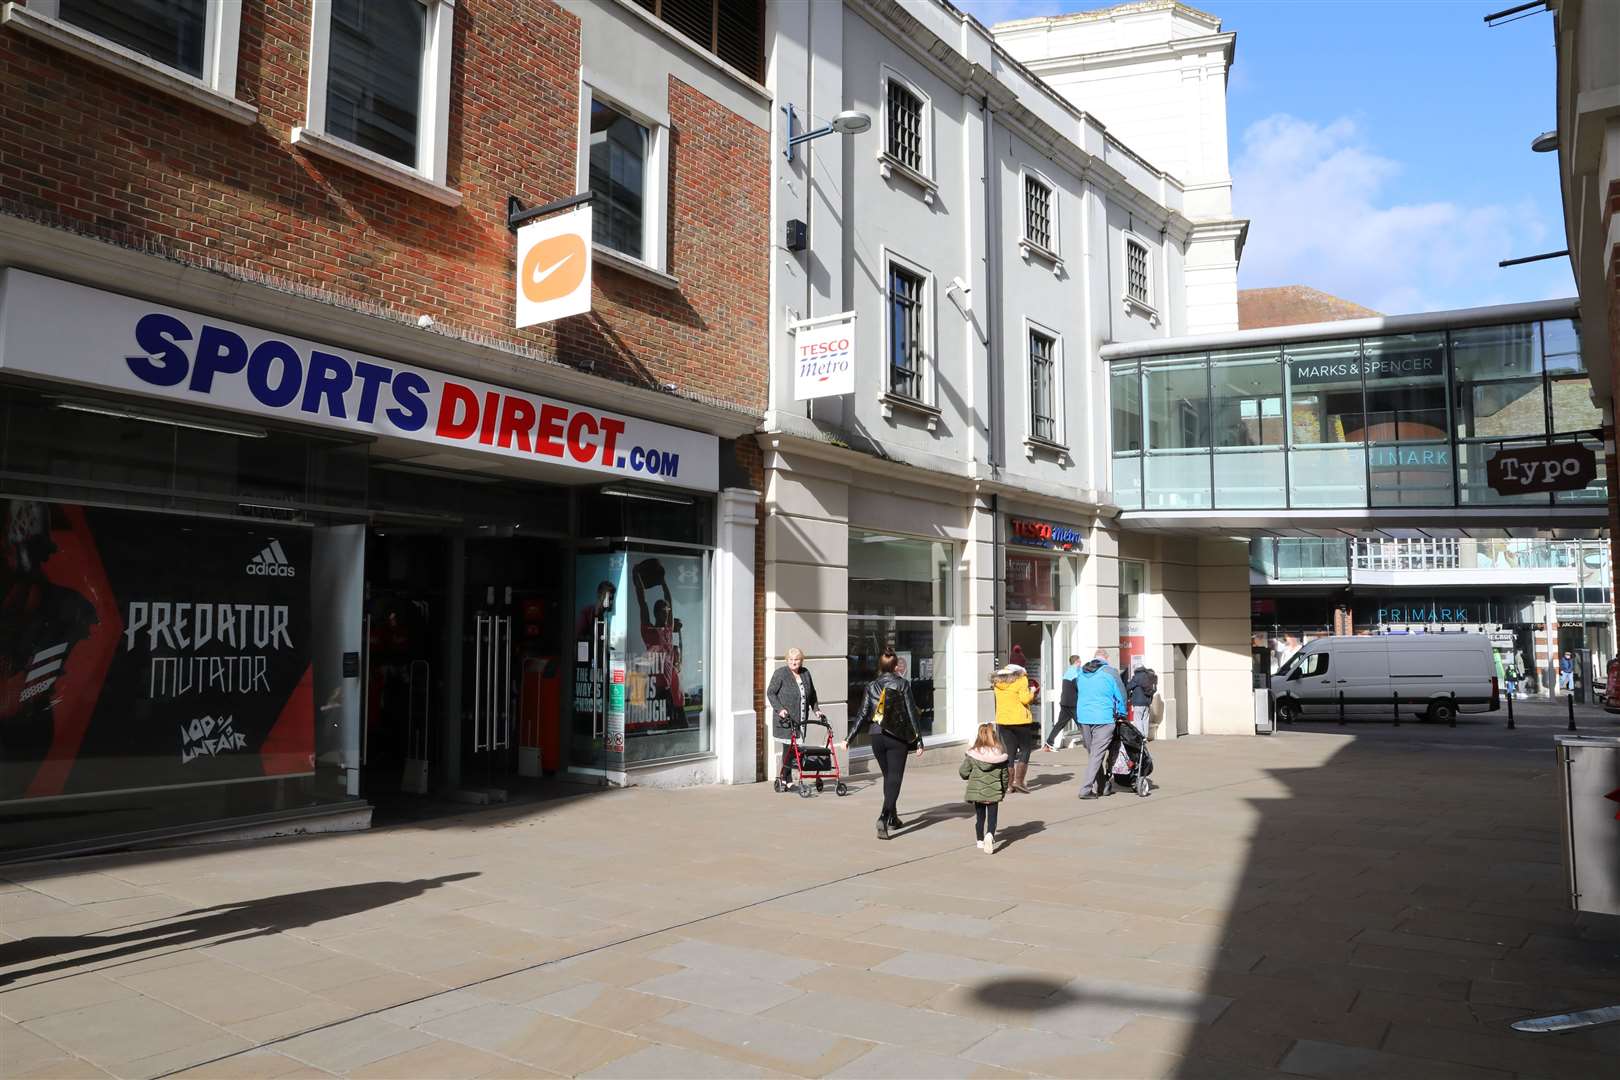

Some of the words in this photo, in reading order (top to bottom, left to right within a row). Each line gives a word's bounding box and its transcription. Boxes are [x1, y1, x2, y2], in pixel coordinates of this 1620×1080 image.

[800, 338, 849, 357] TESCO
[1298, 364, 1347, 379] MARKS
[1349, 363, 1360, 375] &
[1363, 358, 1433, 375] SPENCER
[1500, 458, 1580, 485] Typo
[1012, 519, 1052, 539] TESCO
[246, 561, 296, 577] adidas
[1377, 608, 1467, 622] PRIMARK
[124, 601, 295, 652] PREDATOR
[150, 655, 271, 699] MUTATOR
